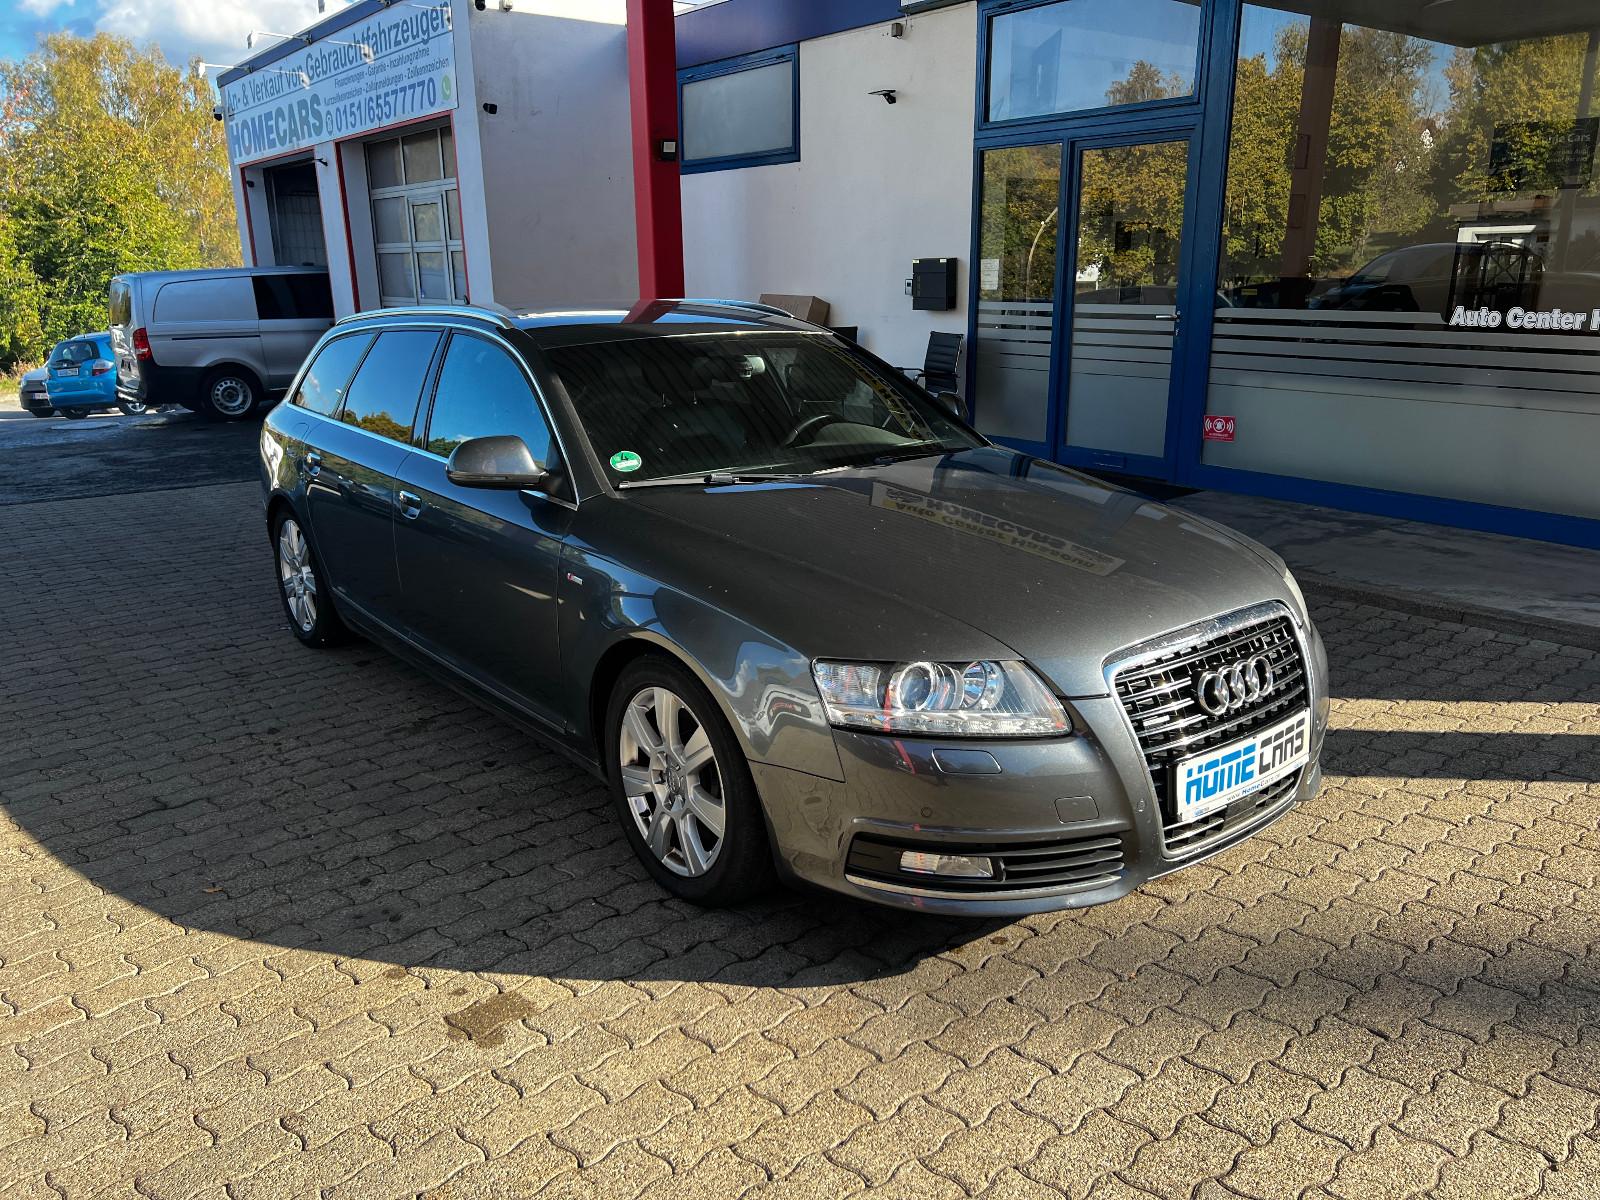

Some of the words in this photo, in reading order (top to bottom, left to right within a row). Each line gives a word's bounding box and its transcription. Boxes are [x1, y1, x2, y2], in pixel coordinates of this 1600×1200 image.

[227, 90, 241, 113] An-
[242, 83, 249, 107] &
[249, 66, 284, 104] Verkauf
[285, 64, 304, 90] von
[336, 77, 437, 133] 0151/65577770
[230, 93, 323, 159] HOMECARS
[1449, 305, 1502, 328] Auto
[1506, 306, 1587, 331] Center
[1185, 742, 1256, 805] HOME
[1259, 717, 1305, 776] CARS
